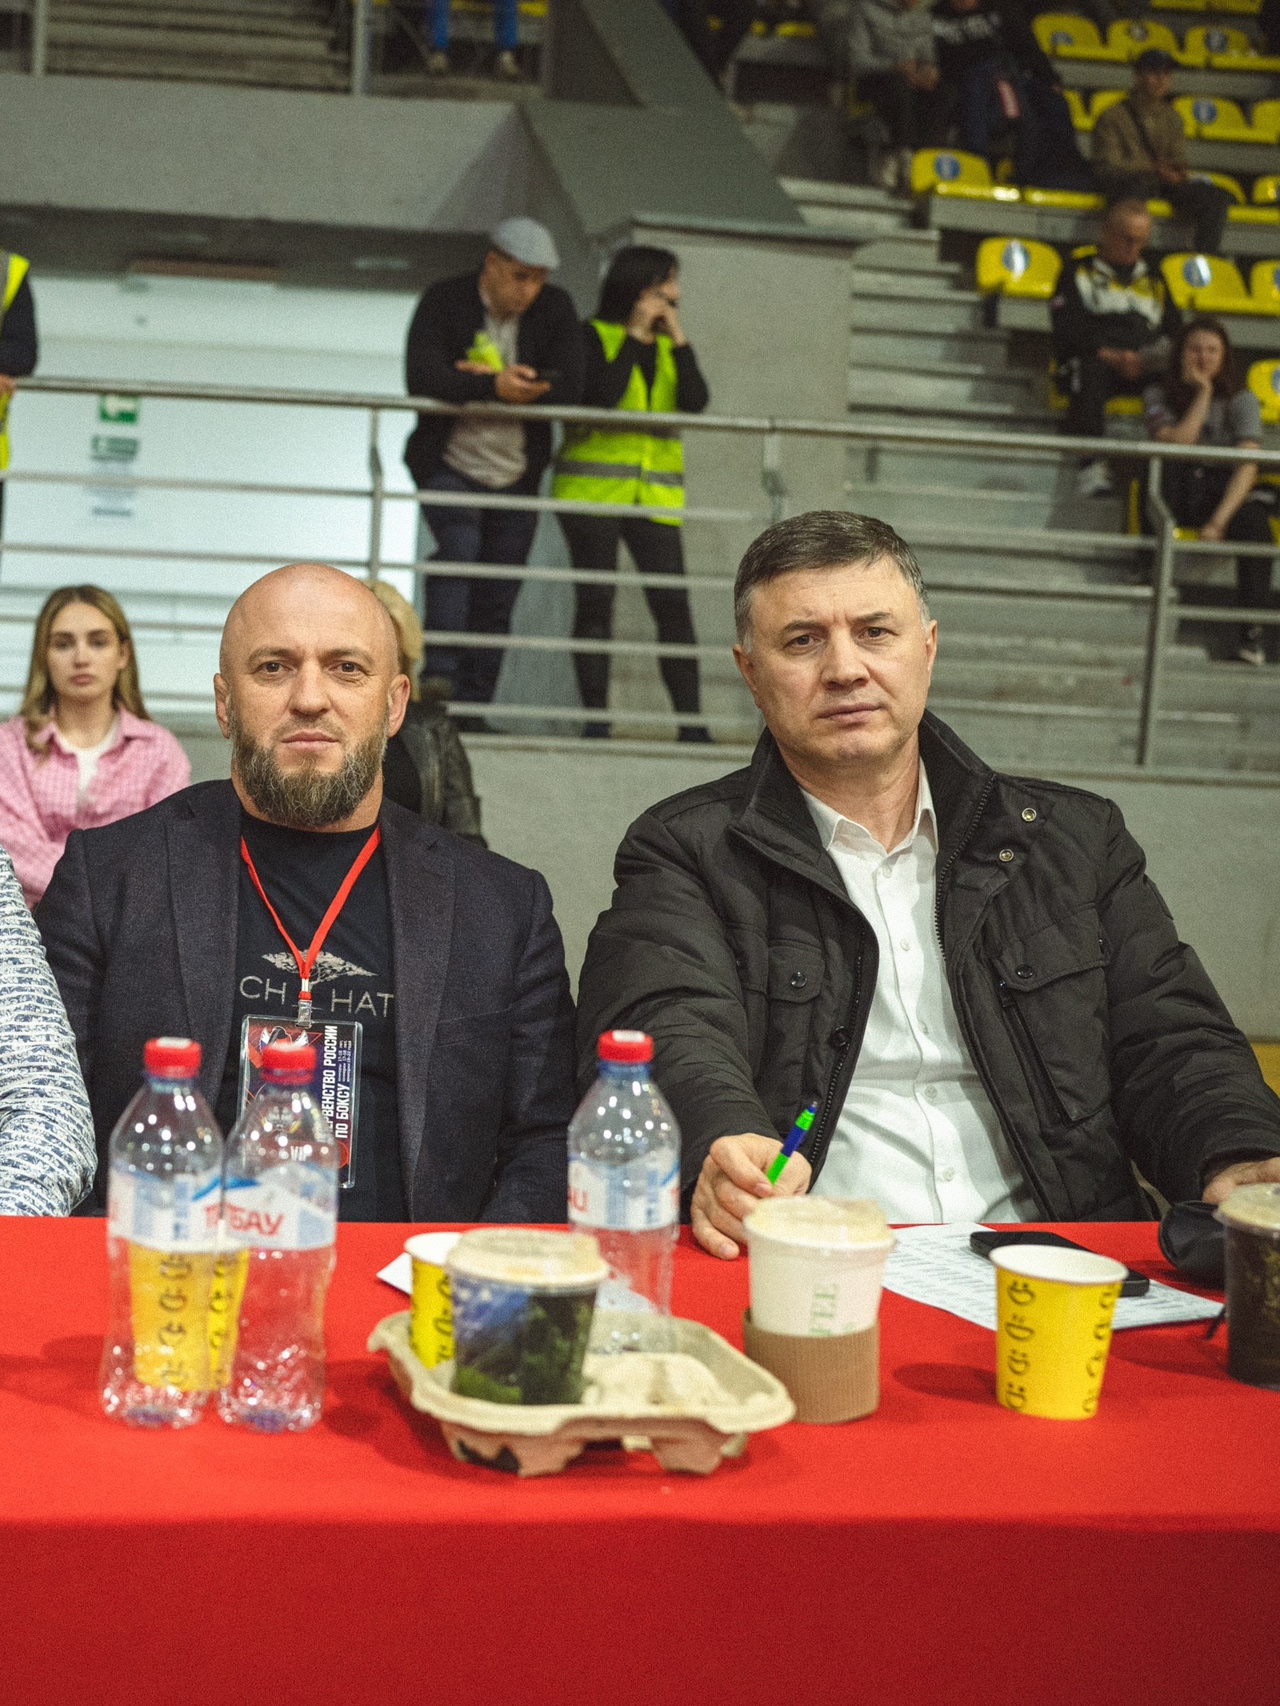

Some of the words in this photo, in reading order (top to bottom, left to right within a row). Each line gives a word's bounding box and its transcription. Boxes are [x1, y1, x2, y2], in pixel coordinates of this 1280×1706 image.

[323, 1025, 338, 1067] РОССИИ
[320, 1069, 336, 1131] ЕРВЕНСТВО
[335, 1083, 351, 1120] БОКСУ
[335, 1122, 348, 1139] ПО
